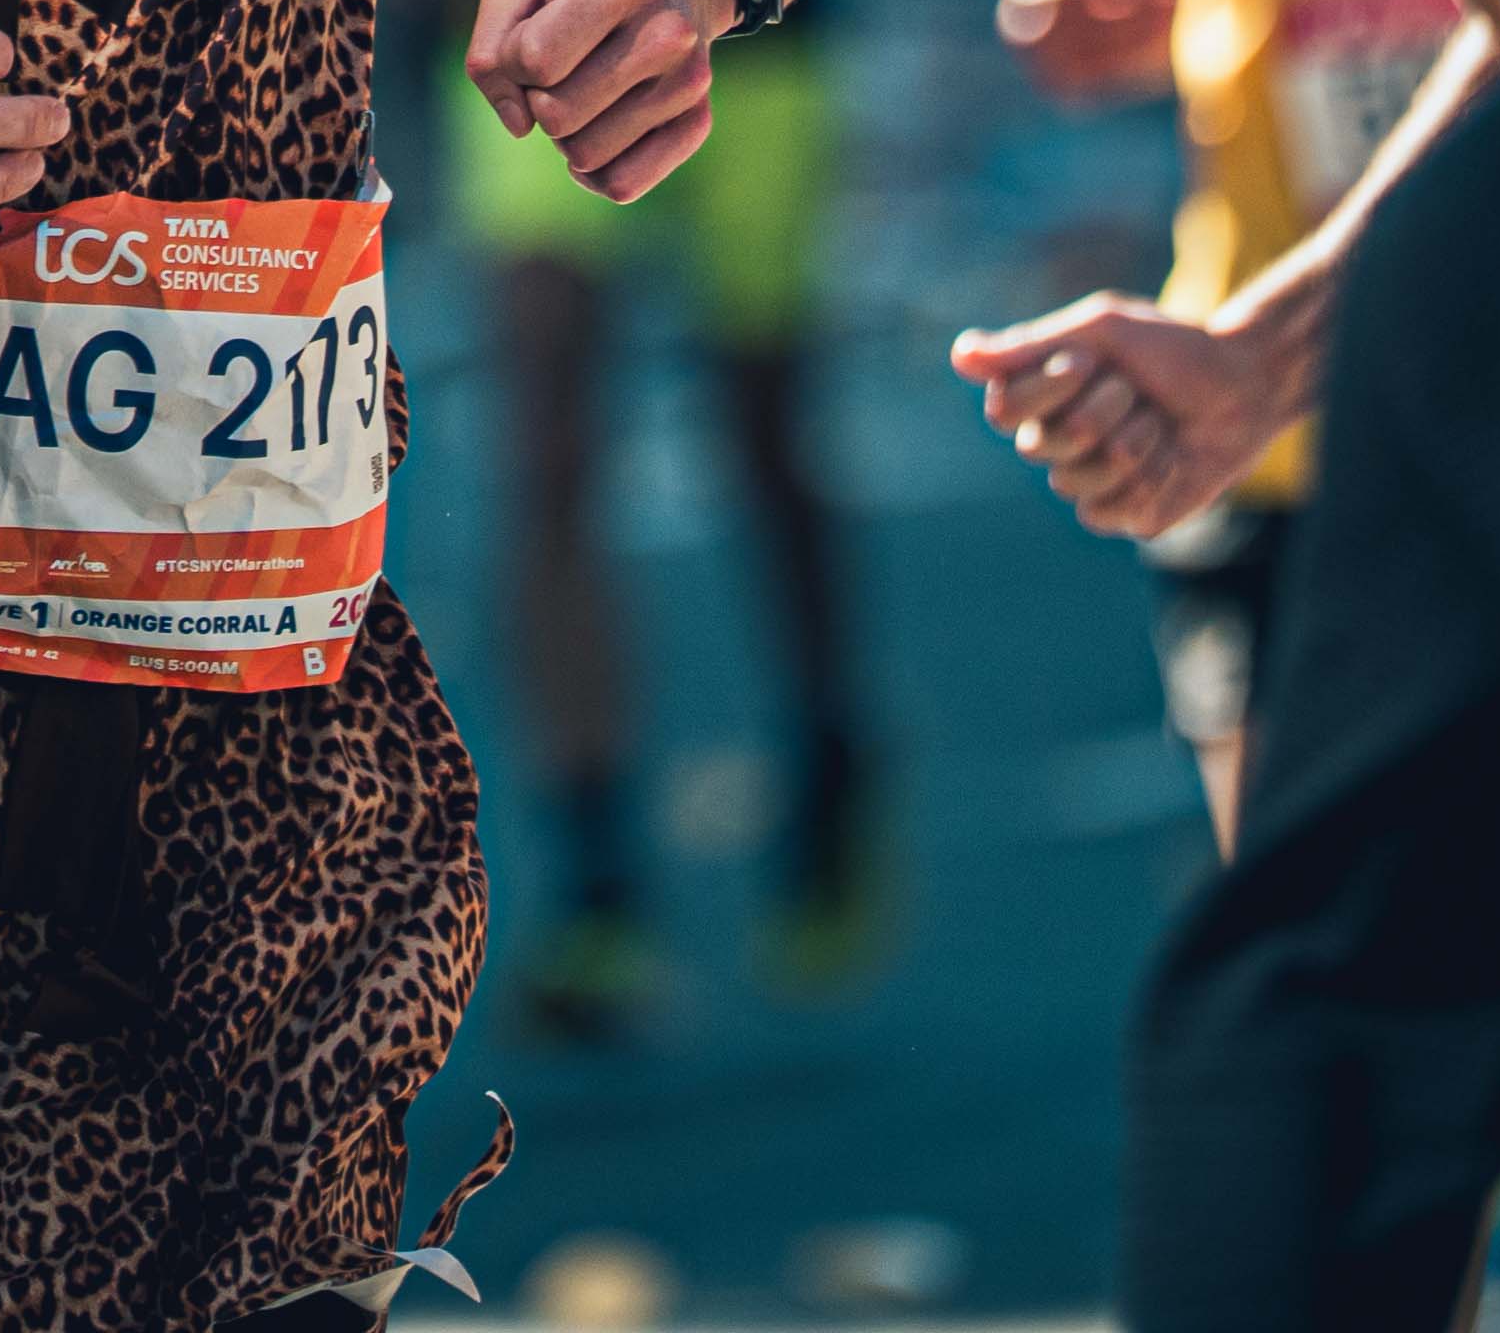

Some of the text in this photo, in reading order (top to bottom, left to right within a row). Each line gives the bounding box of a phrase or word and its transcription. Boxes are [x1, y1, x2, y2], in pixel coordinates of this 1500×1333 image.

[163, 218, 230, 240] TATA
[34, 220, 149, 286] tcs
[162, 244, 319, 271] CONSULTANCY
[160, 269, 260, 294] SERVICES
[155, 556, 305, 573] #TCSNYCMarathon
[30, 601, 49, 629] 1
[70, 605, 297, 635] ORANGE CORRAL A
[128, 654, 239, 675] BUS 5:00AM
[302, 647, 327, 676] B
